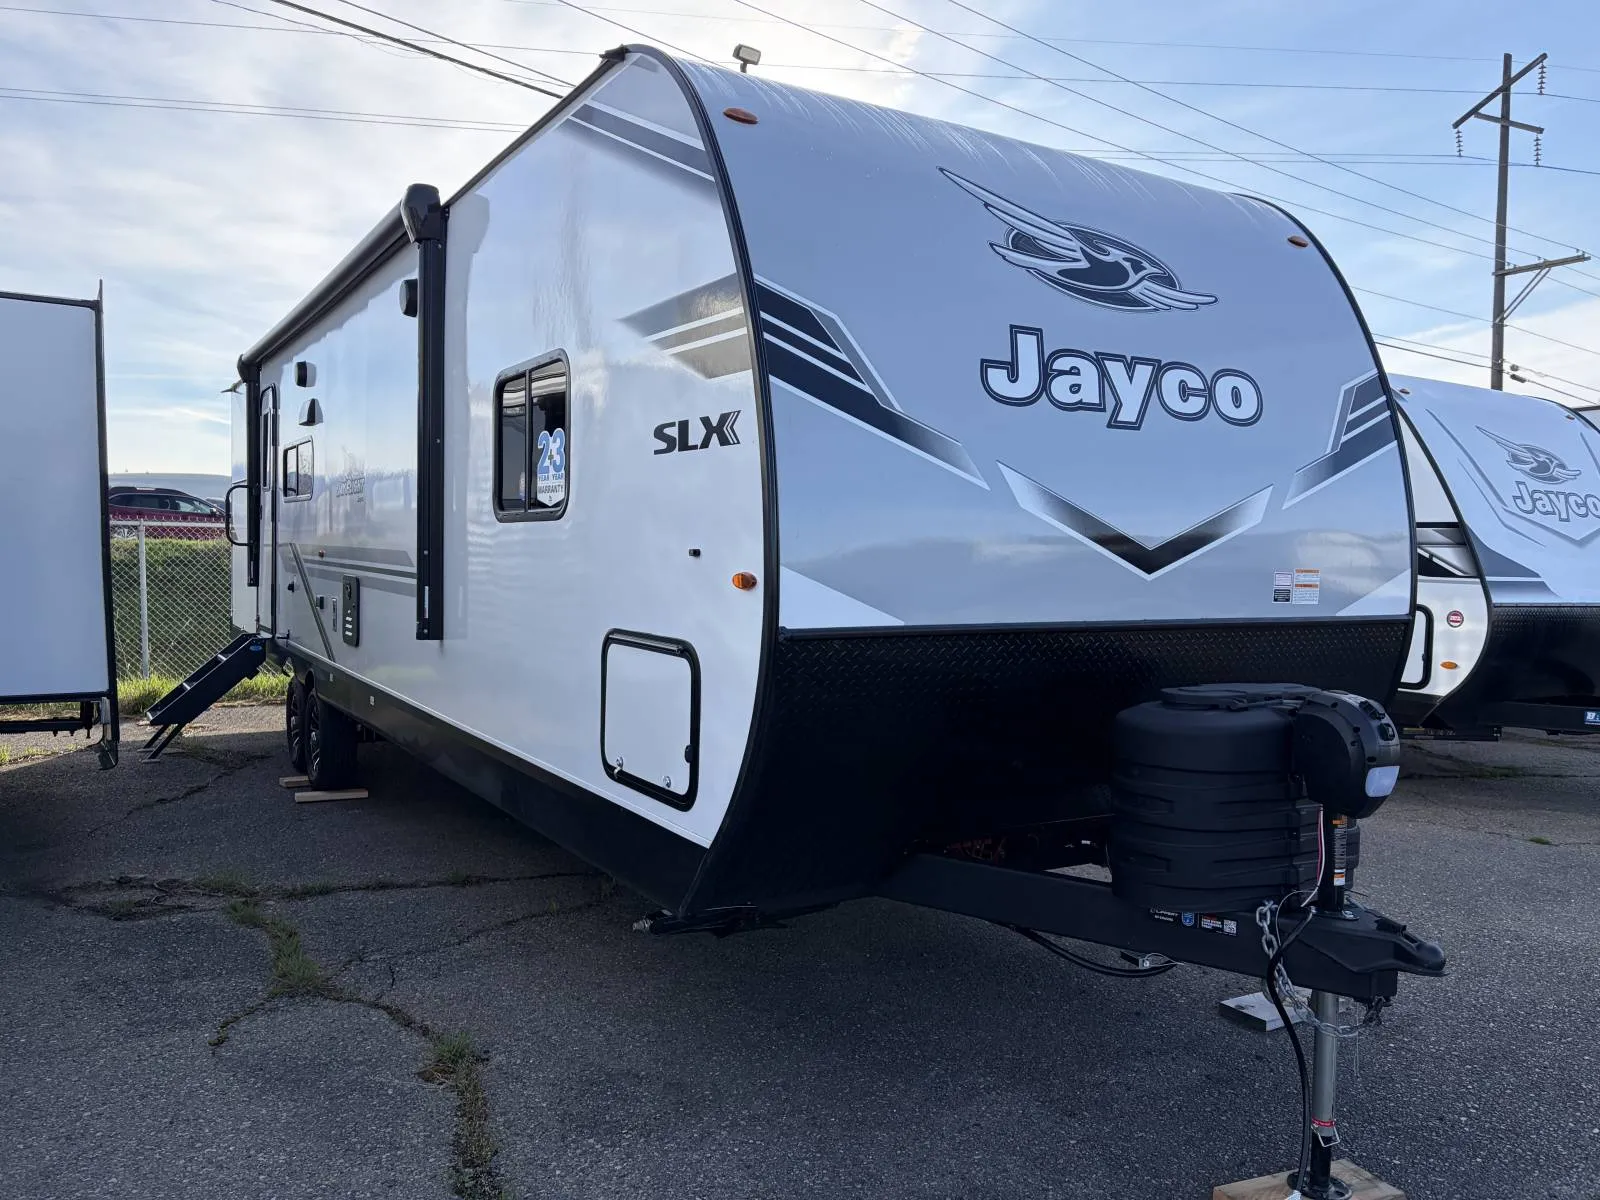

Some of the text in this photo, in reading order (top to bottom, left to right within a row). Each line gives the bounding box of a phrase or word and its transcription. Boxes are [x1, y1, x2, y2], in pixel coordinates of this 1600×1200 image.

[980, 324, 1263, 431] Jayco
[653, 410, 741, 455] SLX
[538, 484, 563, 494] WARRANTY
